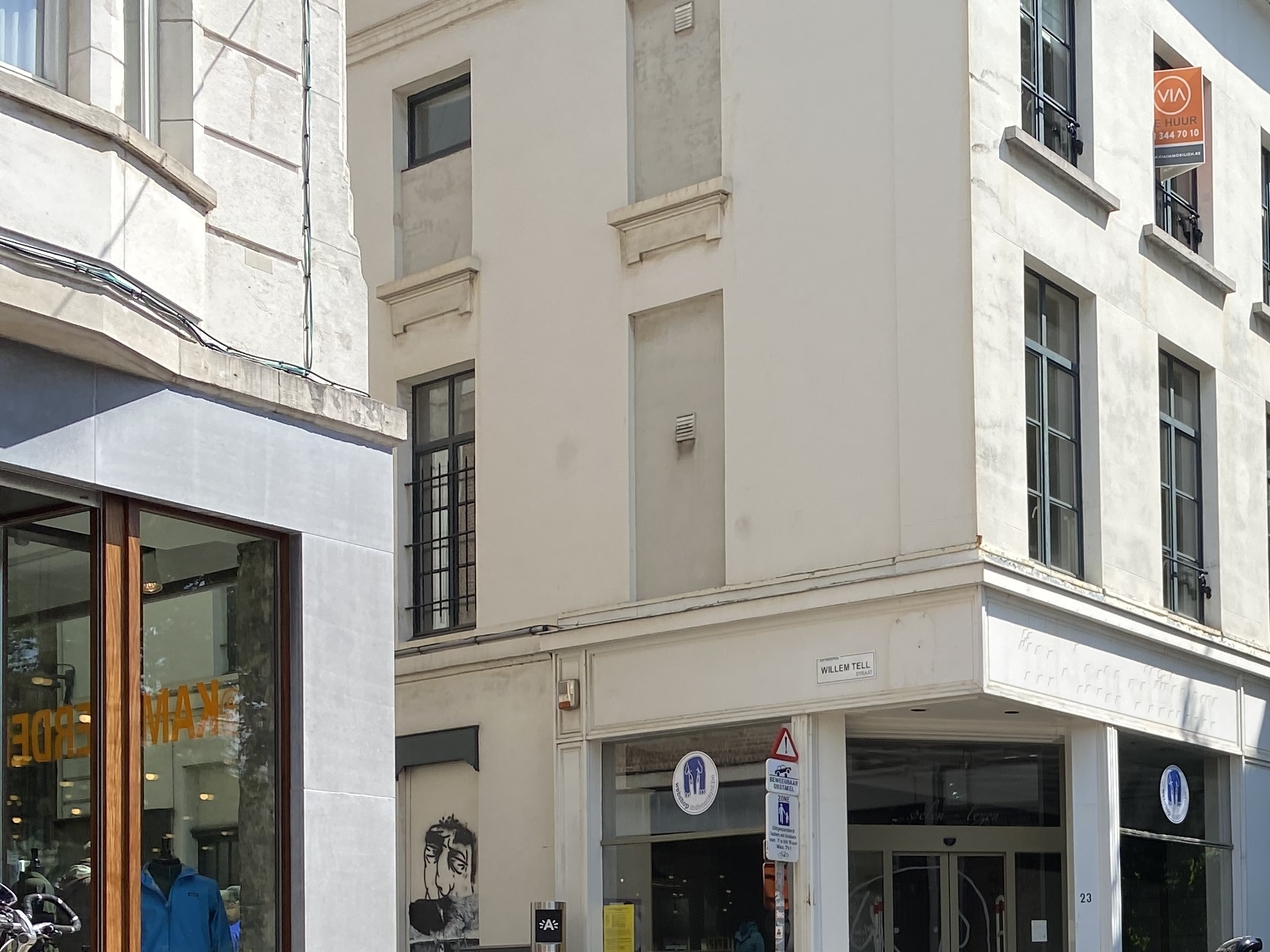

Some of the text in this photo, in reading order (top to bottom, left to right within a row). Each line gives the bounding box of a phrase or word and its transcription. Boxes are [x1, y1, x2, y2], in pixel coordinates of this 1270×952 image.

[1157, 87, 1187, 103] VIA
[1165, 116, 1197, 127] HUUR
[1159, 131, 1174, 140] 344
[1177, 130, 1188, 139] 70
[1190, 128, 1200, 137] 10
[821, 661, 871, 674] WILLEM TELL
[773, 784, 795, 792] OBSTAKEL
[1080, 892, 1092, 903] 23
